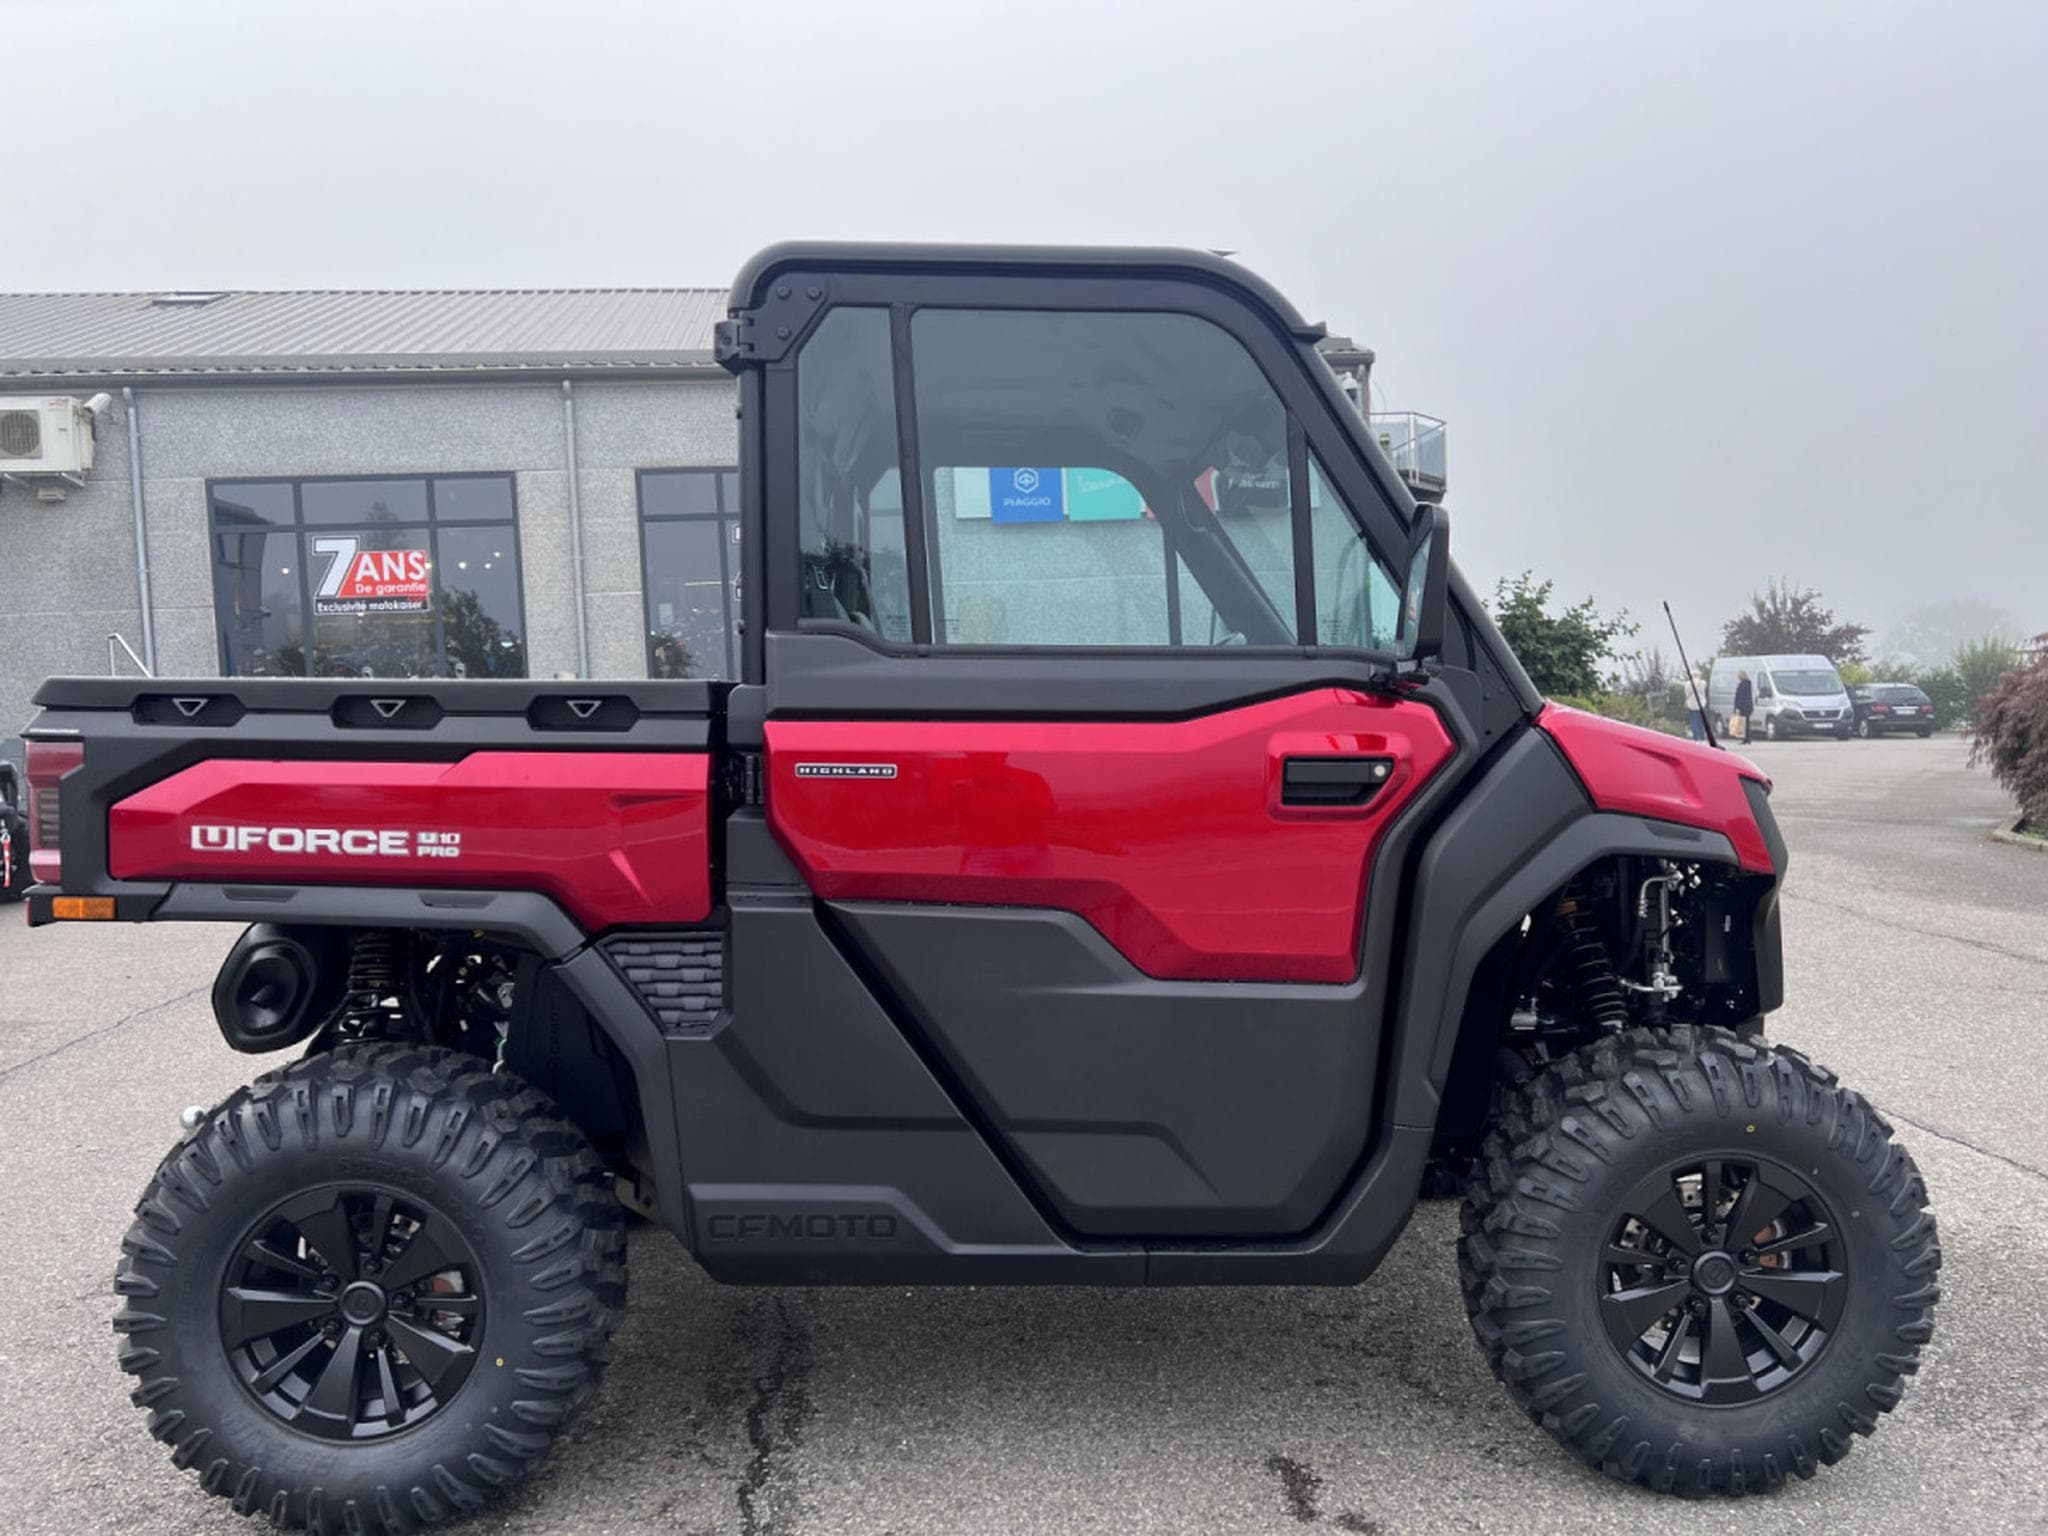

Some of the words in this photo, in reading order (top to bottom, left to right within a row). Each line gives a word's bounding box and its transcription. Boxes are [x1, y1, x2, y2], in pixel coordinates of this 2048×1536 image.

[1003, 497, 1051, 507] PIAGGIO
[315, 539, 357, 597] 7
[355, 552, 425, 582] ANS
[355, 583, 372, 594] De
[375, 582, 426, 595] garantie
[799, 767, 893, 775] HIGHLAND
[191, 825, 409, 855] UFORCE
[416, 846, 460, 857] PRO
[707, 1214, 897, 1239] CFMOTO
